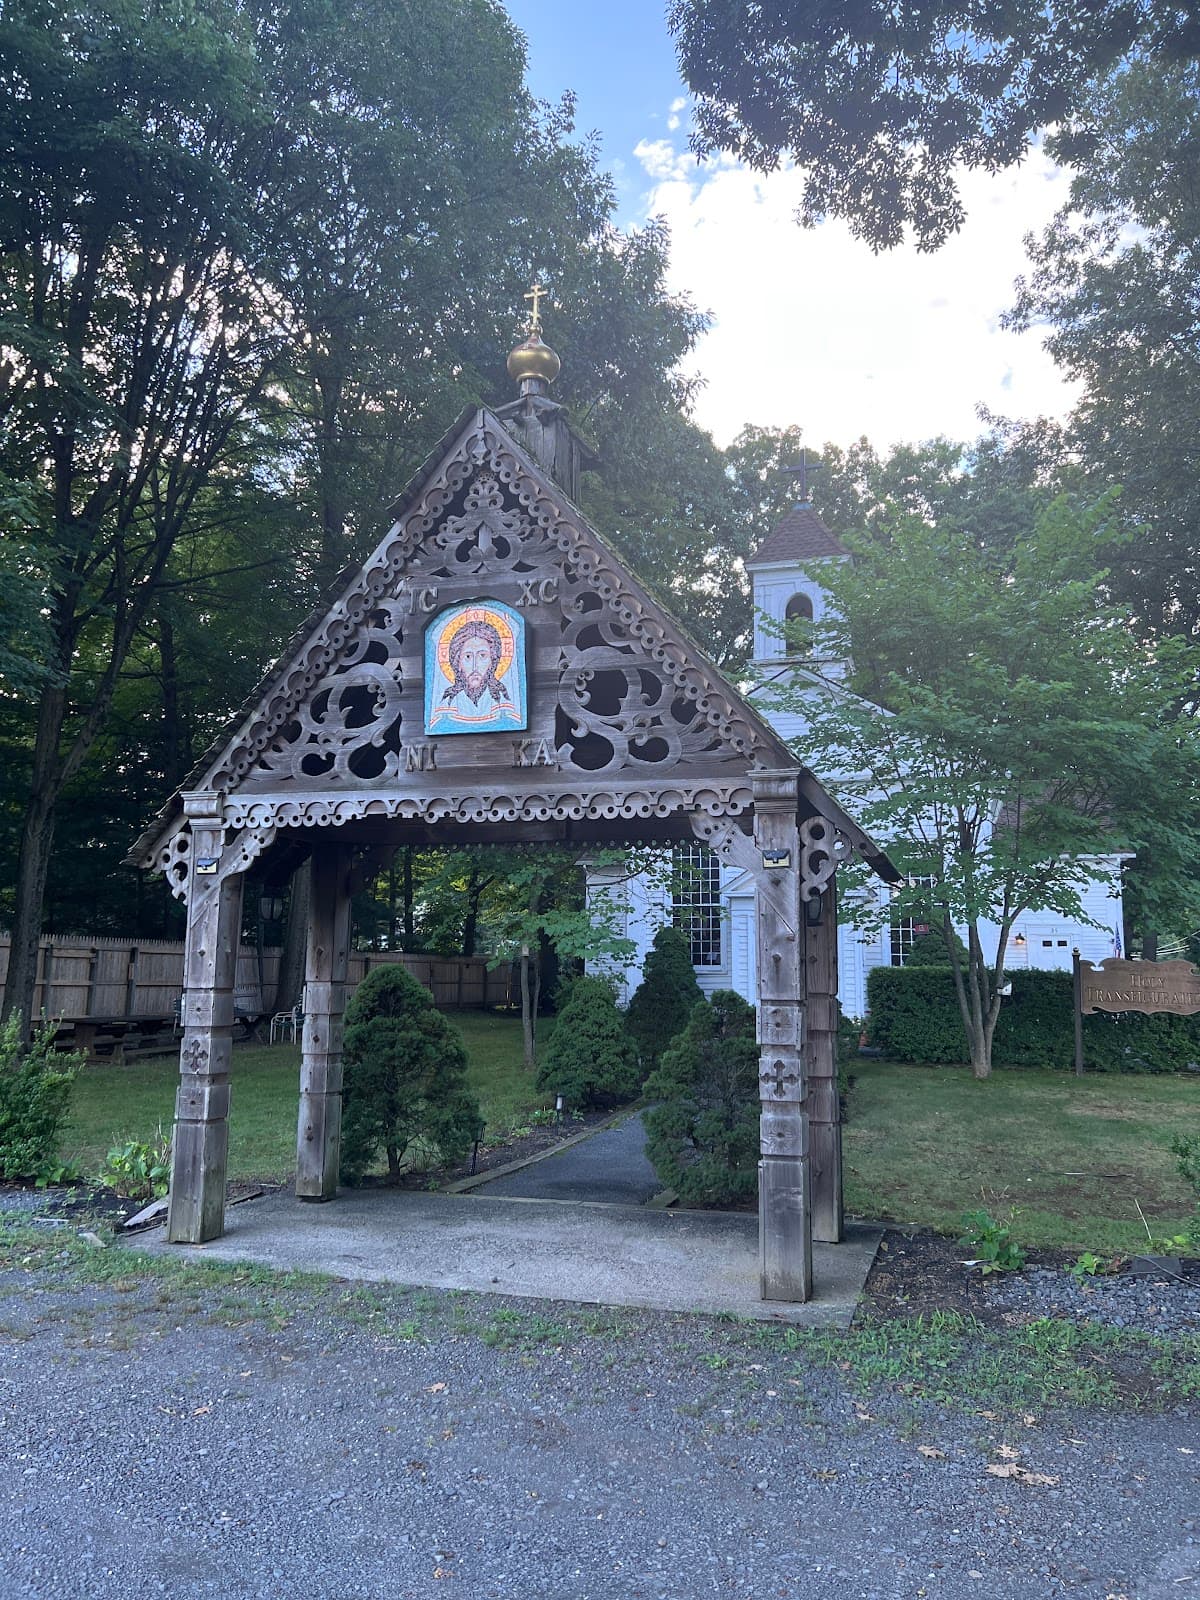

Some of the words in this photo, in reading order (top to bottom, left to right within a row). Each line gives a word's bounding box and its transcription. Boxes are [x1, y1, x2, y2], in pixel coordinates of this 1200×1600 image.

[516, 579, 558, 605] XC
[406, 745, 437, 771] NI
[512, 739, 554, 767] KA
